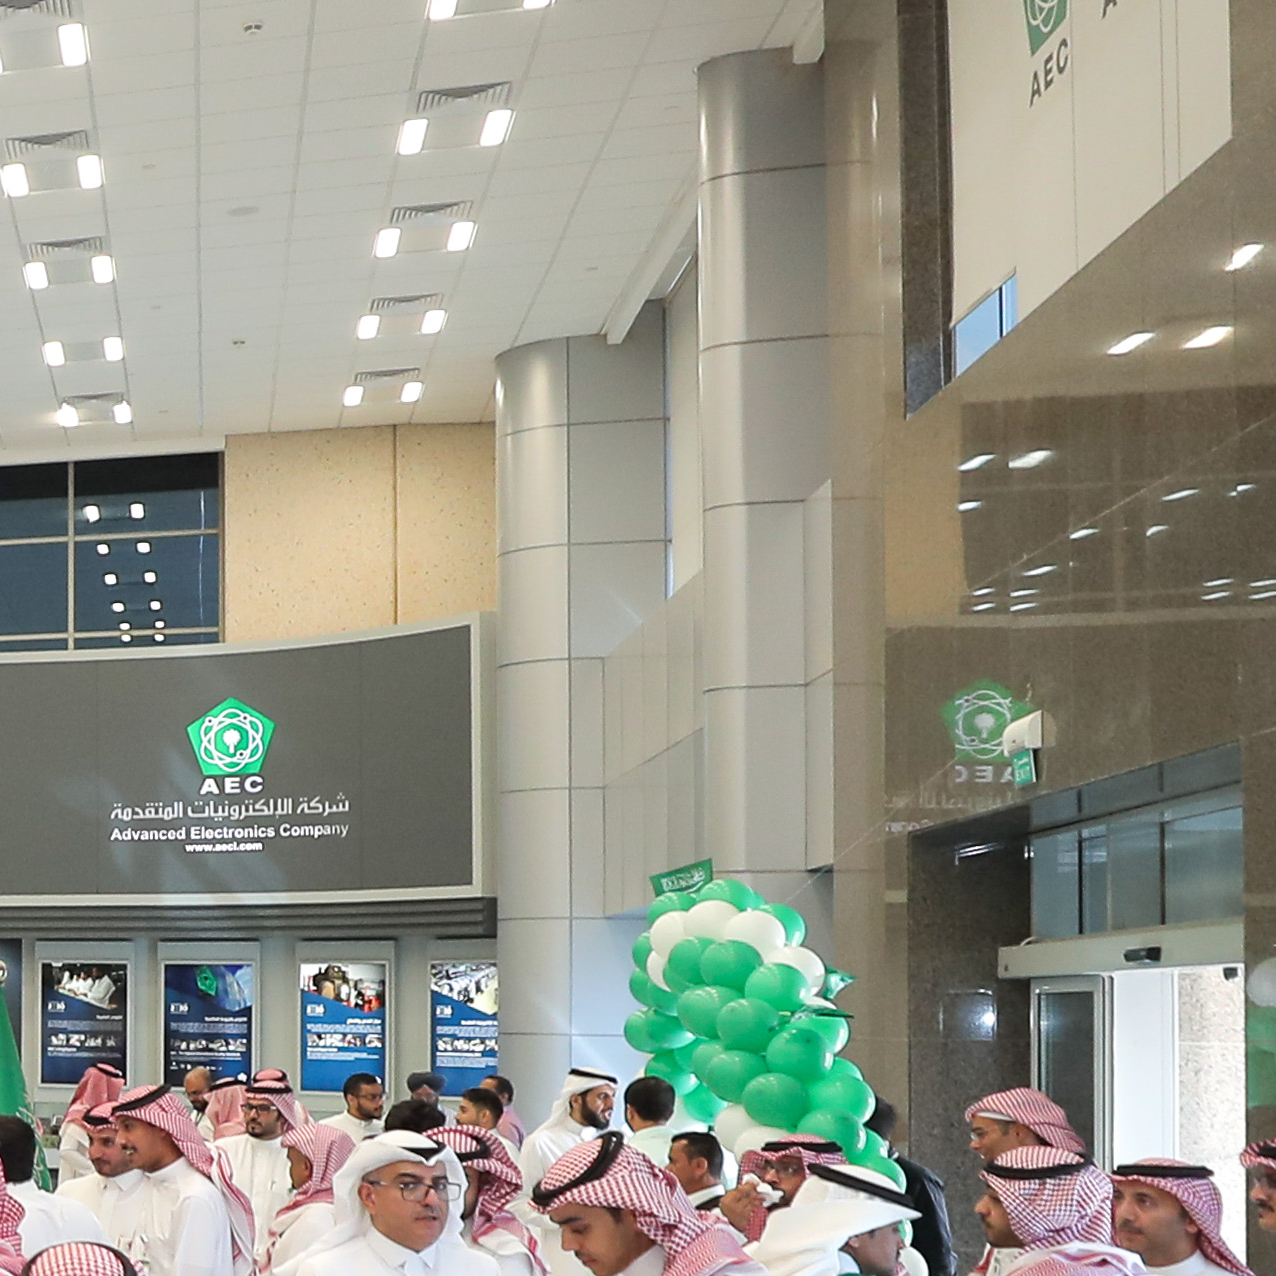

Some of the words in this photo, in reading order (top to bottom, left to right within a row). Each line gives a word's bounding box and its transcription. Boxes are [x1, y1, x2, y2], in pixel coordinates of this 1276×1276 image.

[1029, 37, 1069, 108] AEC
[199, 776, 264, 795] AEC
[110, 801, 183, 822] المتقدمة
[297, 793, 350, 817] شركة
[110, 827, 186, 841] Advanced
[190, 825, 275, 840] Electronics
[279, 823, 349, 838] Company
[185, 841, 263, 853] www.aecl.com
